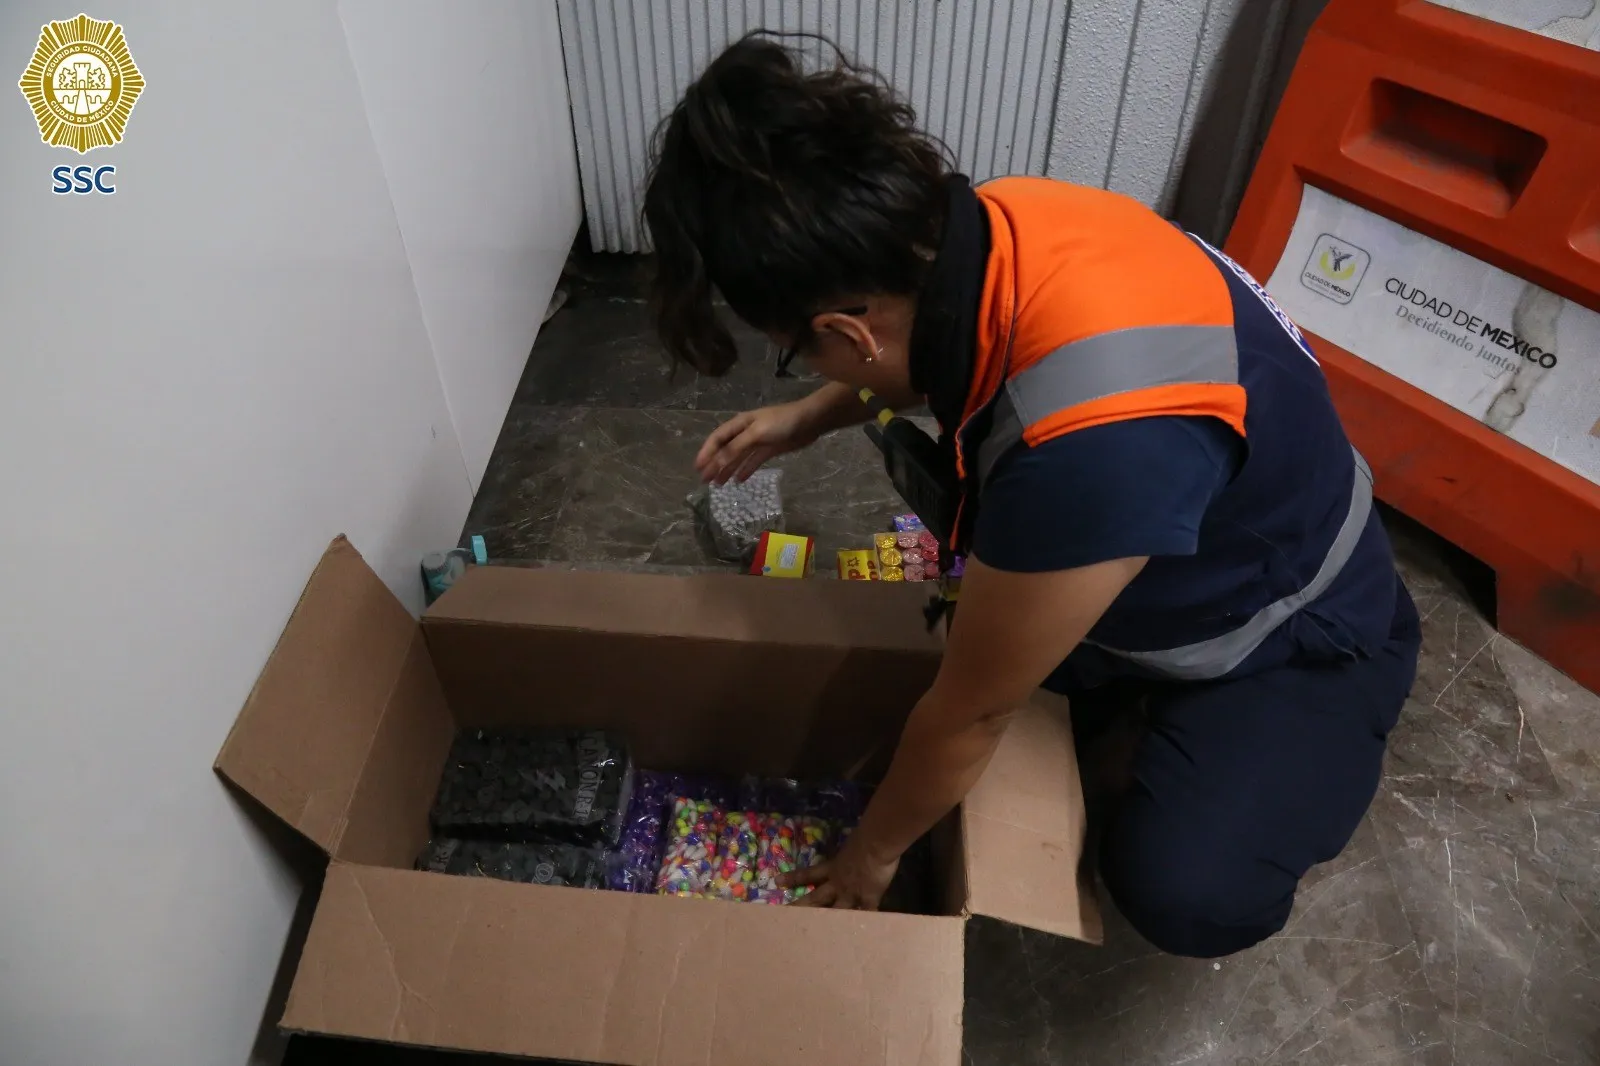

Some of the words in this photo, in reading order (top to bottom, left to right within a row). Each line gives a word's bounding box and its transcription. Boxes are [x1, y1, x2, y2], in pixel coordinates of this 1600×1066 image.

[1385, 278, 1453, 318] CIUDAD
[1452, 309, 1483, 333] DE
[1480, 322, 1557, 369] MEXICO
[1395, 305, 1474, 352] Decidiendo
[1475, 345, 1523, 375] Juntos
